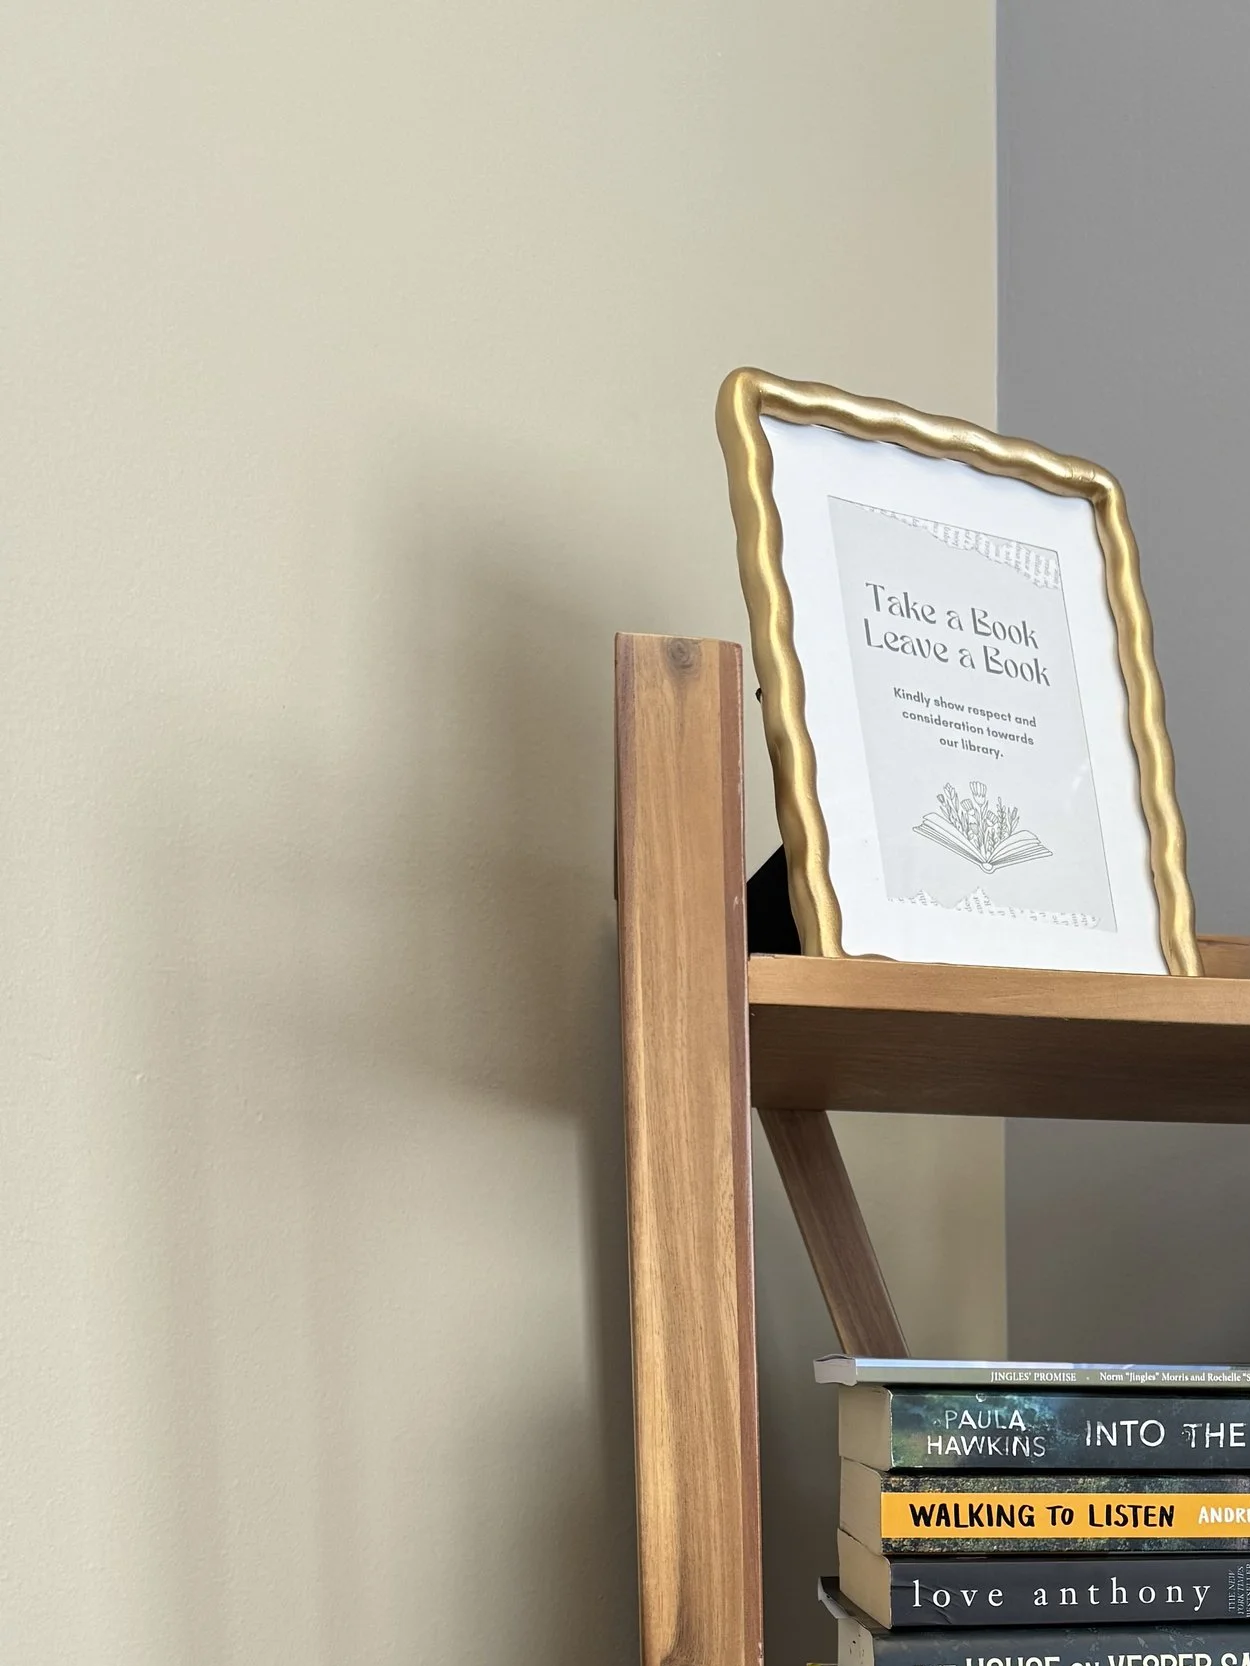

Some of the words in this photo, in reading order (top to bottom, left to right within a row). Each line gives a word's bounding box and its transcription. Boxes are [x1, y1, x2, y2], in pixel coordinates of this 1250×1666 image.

[864, 582, 937, 625] Take
[946, 609, 964, 631] a
[971, 607, 1038, 649] Book
[863, 618, 949, 663] Leave
[959, 648, 975, 669] a
[984, 646, 1050, 687] Book
[893, 687, 930, 708] Kindly
[933, 697, 965, 712] show
[967, 705, 1012, 723] respect
[1015, 713, 1037, 727] and
[902, 709, 984, 736] consideration
[986, 727, 1034, 745] towards
[939, 736, 959, 748] our
[961, 740, 1004, 759] library.
[1034, 1372, 1076, 1382] PROMISE
[945, 1410, 1026, 1431] PAULA
[1086, 1420, 1165, 1447] INTO
[1183, 1422, 1246, 1448] THE
[928, 1436, 1046, 1457] HAWKINS
[909, 1503, 1034, 1528] WALKING
[1046, 1505, 1074, 1526] TO
[1089, 1504, 1175, 1527] LISTEN
[913, 1580, 1004, 1608] love
[1033, 1577, 1211, 1611] anthony
